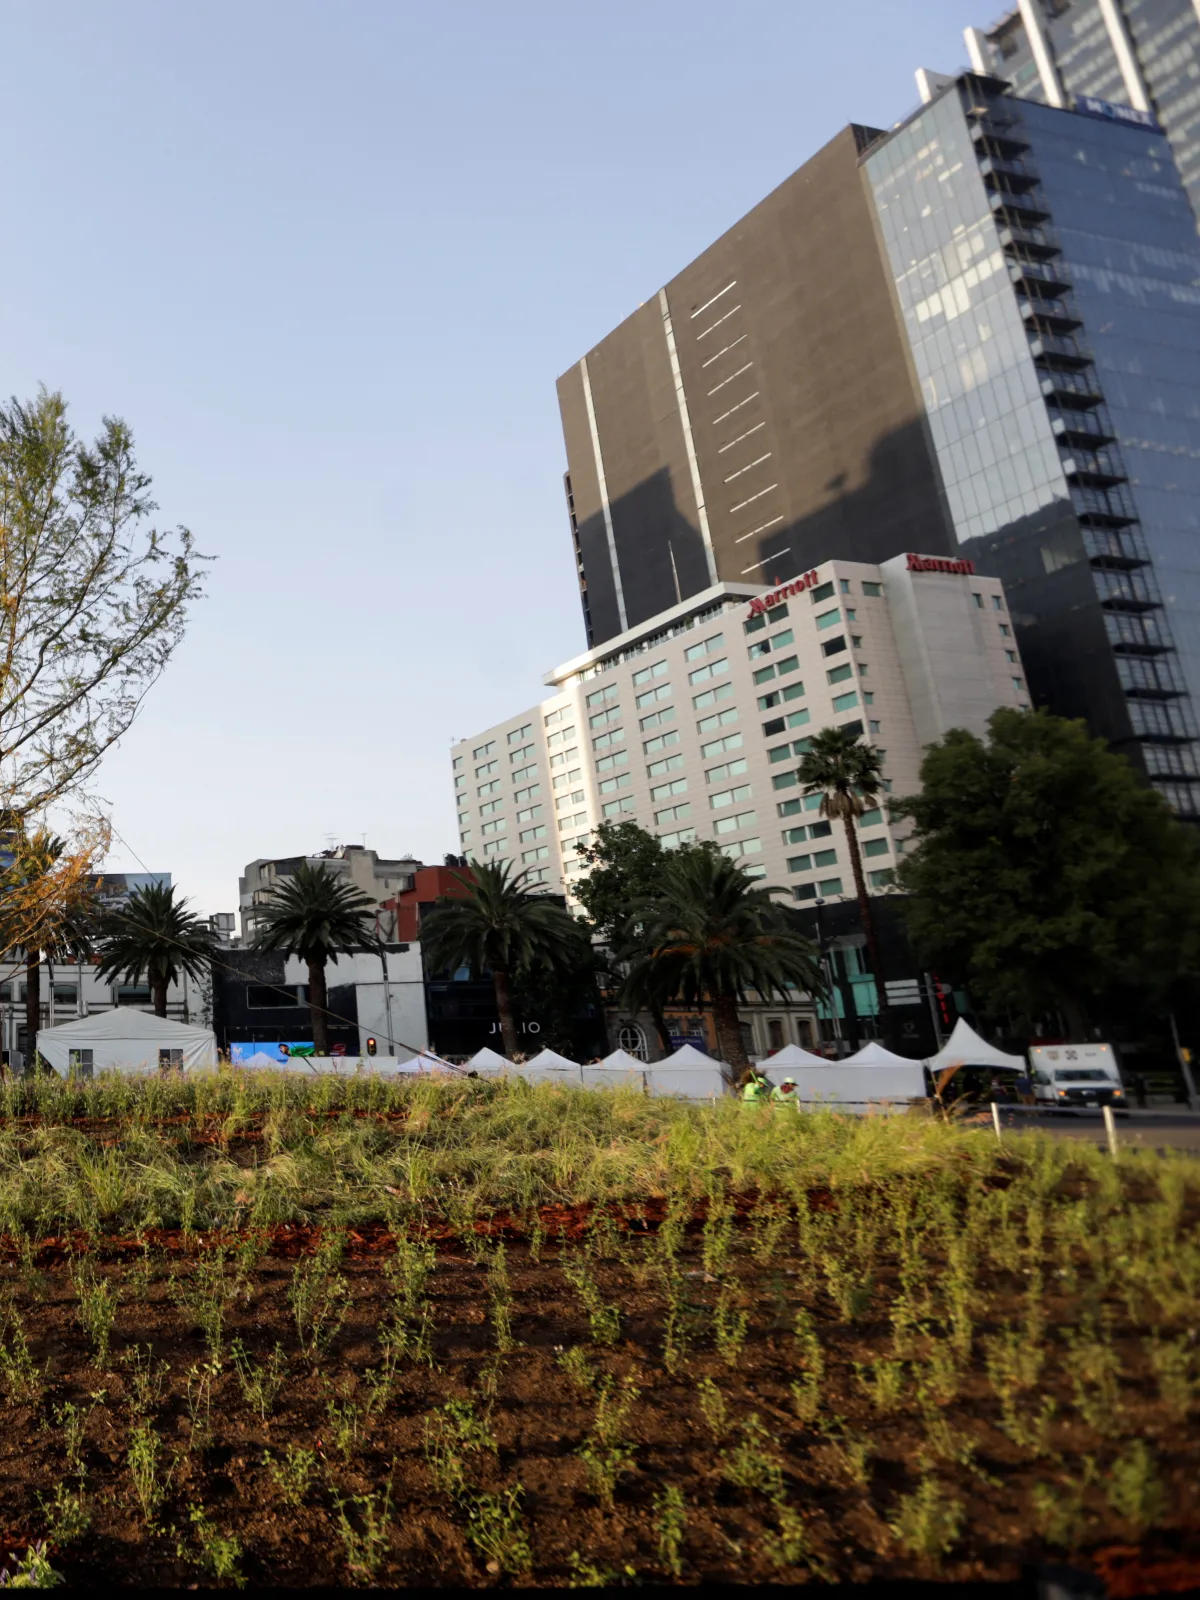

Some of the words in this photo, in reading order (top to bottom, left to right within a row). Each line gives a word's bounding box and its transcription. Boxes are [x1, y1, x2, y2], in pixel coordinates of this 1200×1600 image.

[906, 553, 976, 574] Marriott
[747, 569, 819, 618] Marriott
[489, 1021, 540, 1034] JIO
